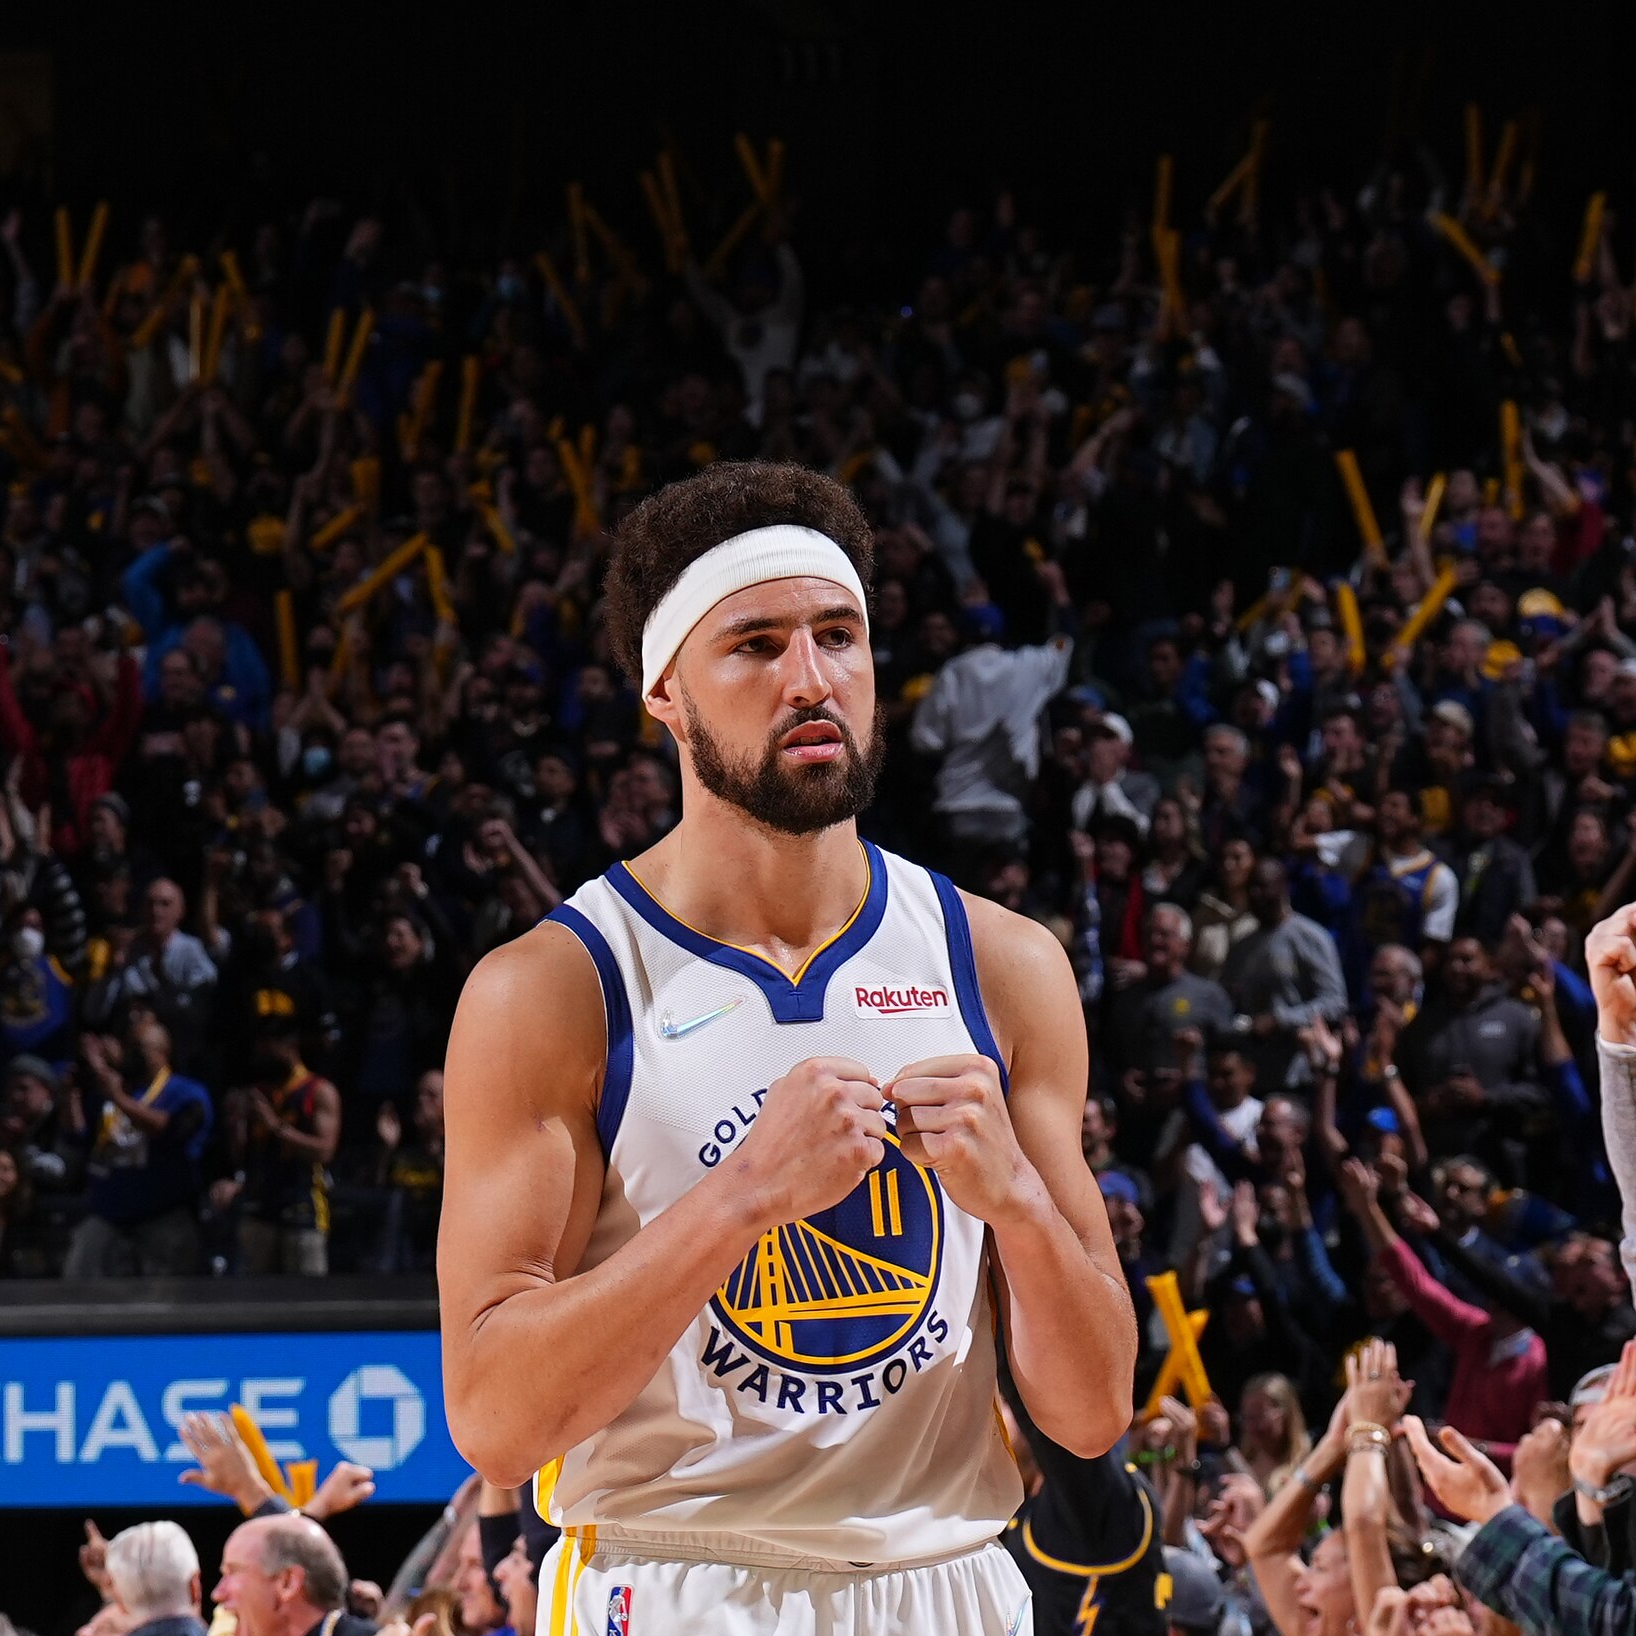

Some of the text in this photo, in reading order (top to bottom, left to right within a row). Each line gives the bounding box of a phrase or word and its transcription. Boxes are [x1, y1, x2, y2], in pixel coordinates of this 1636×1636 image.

[855, 986, 948, 1008] Rakuten
[868, 1168, 903, 1238] 11
[700, 1310, 949, 1415] WARRIORS
